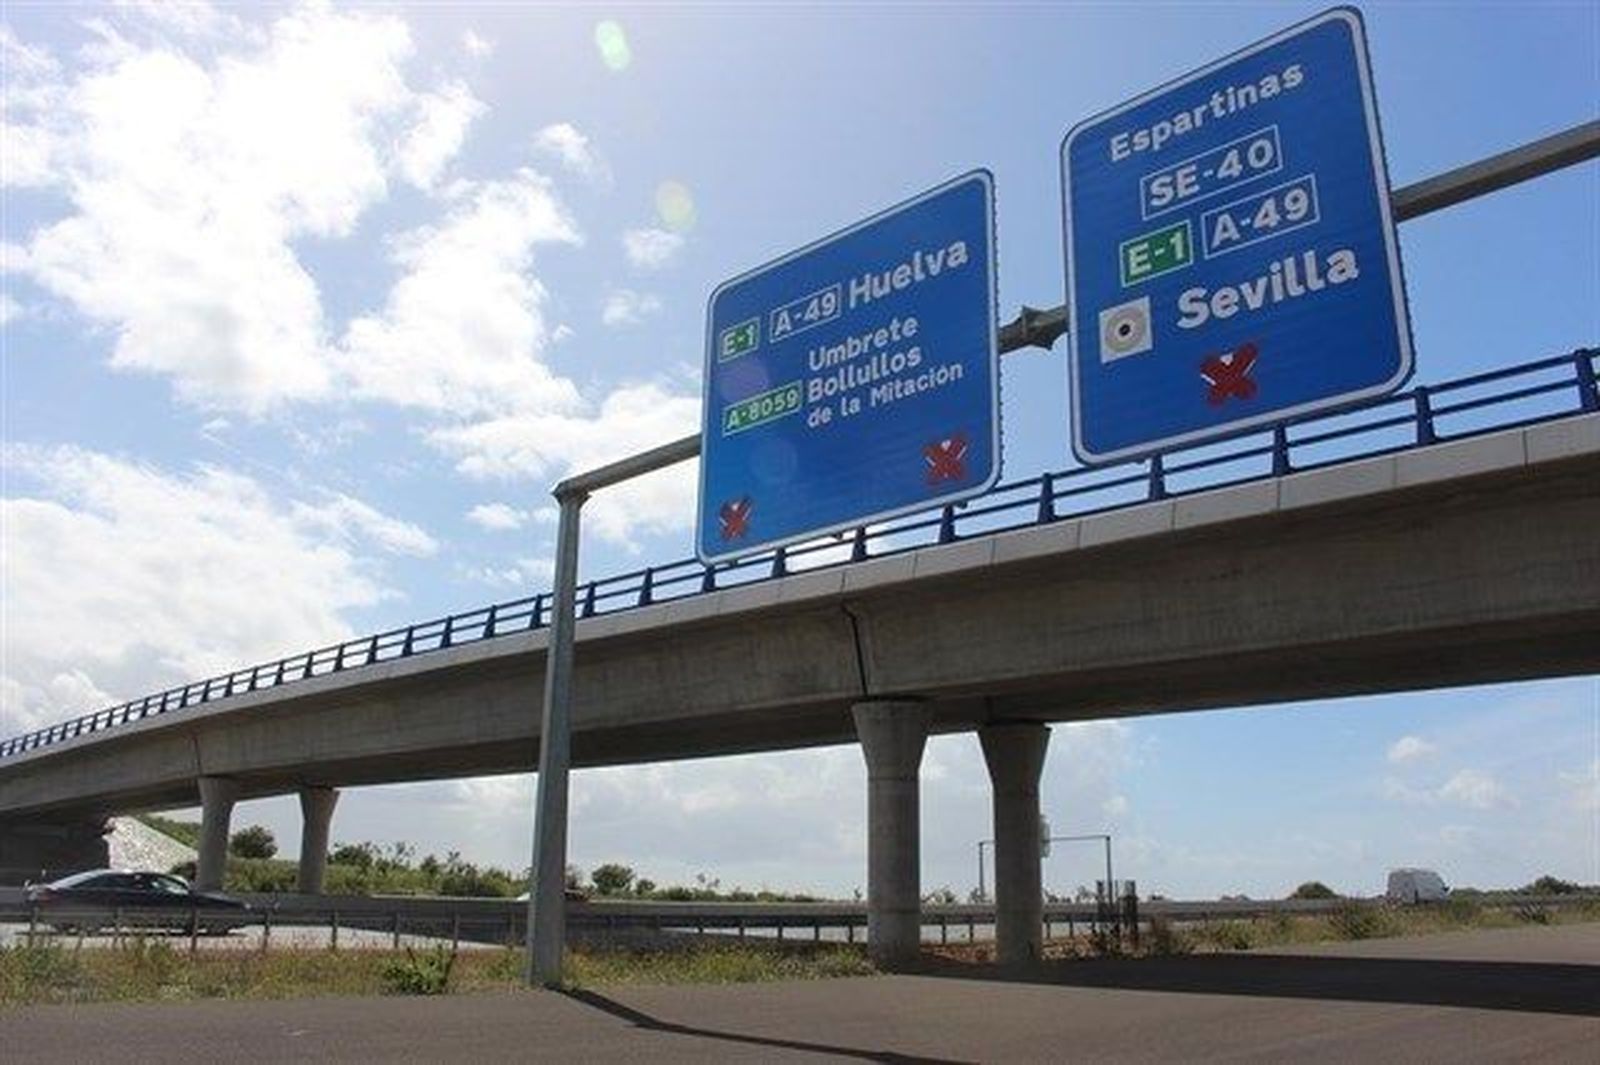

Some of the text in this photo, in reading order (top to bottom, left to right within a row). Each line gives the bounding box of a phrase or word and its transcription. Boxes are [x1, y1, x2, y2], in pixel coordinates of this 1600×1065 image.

[1110, 63, 1304, 162] Espartinas
[1149, 139, 1275, 207] SE-40
[1127, 188, 1309, 275] E-1 A-49
[722, 239, 969, 357] E-1 A-49 Huelva
[1176, 248, 1360, 330] Sevilla
[808, 316, 919, 372] Umbrete
[808, 346, 922, 403] Bollullos
[726, 391, 798, 431] A-8059
[807, 404, 832, 429] de
[840, 394, 860, 417] la
